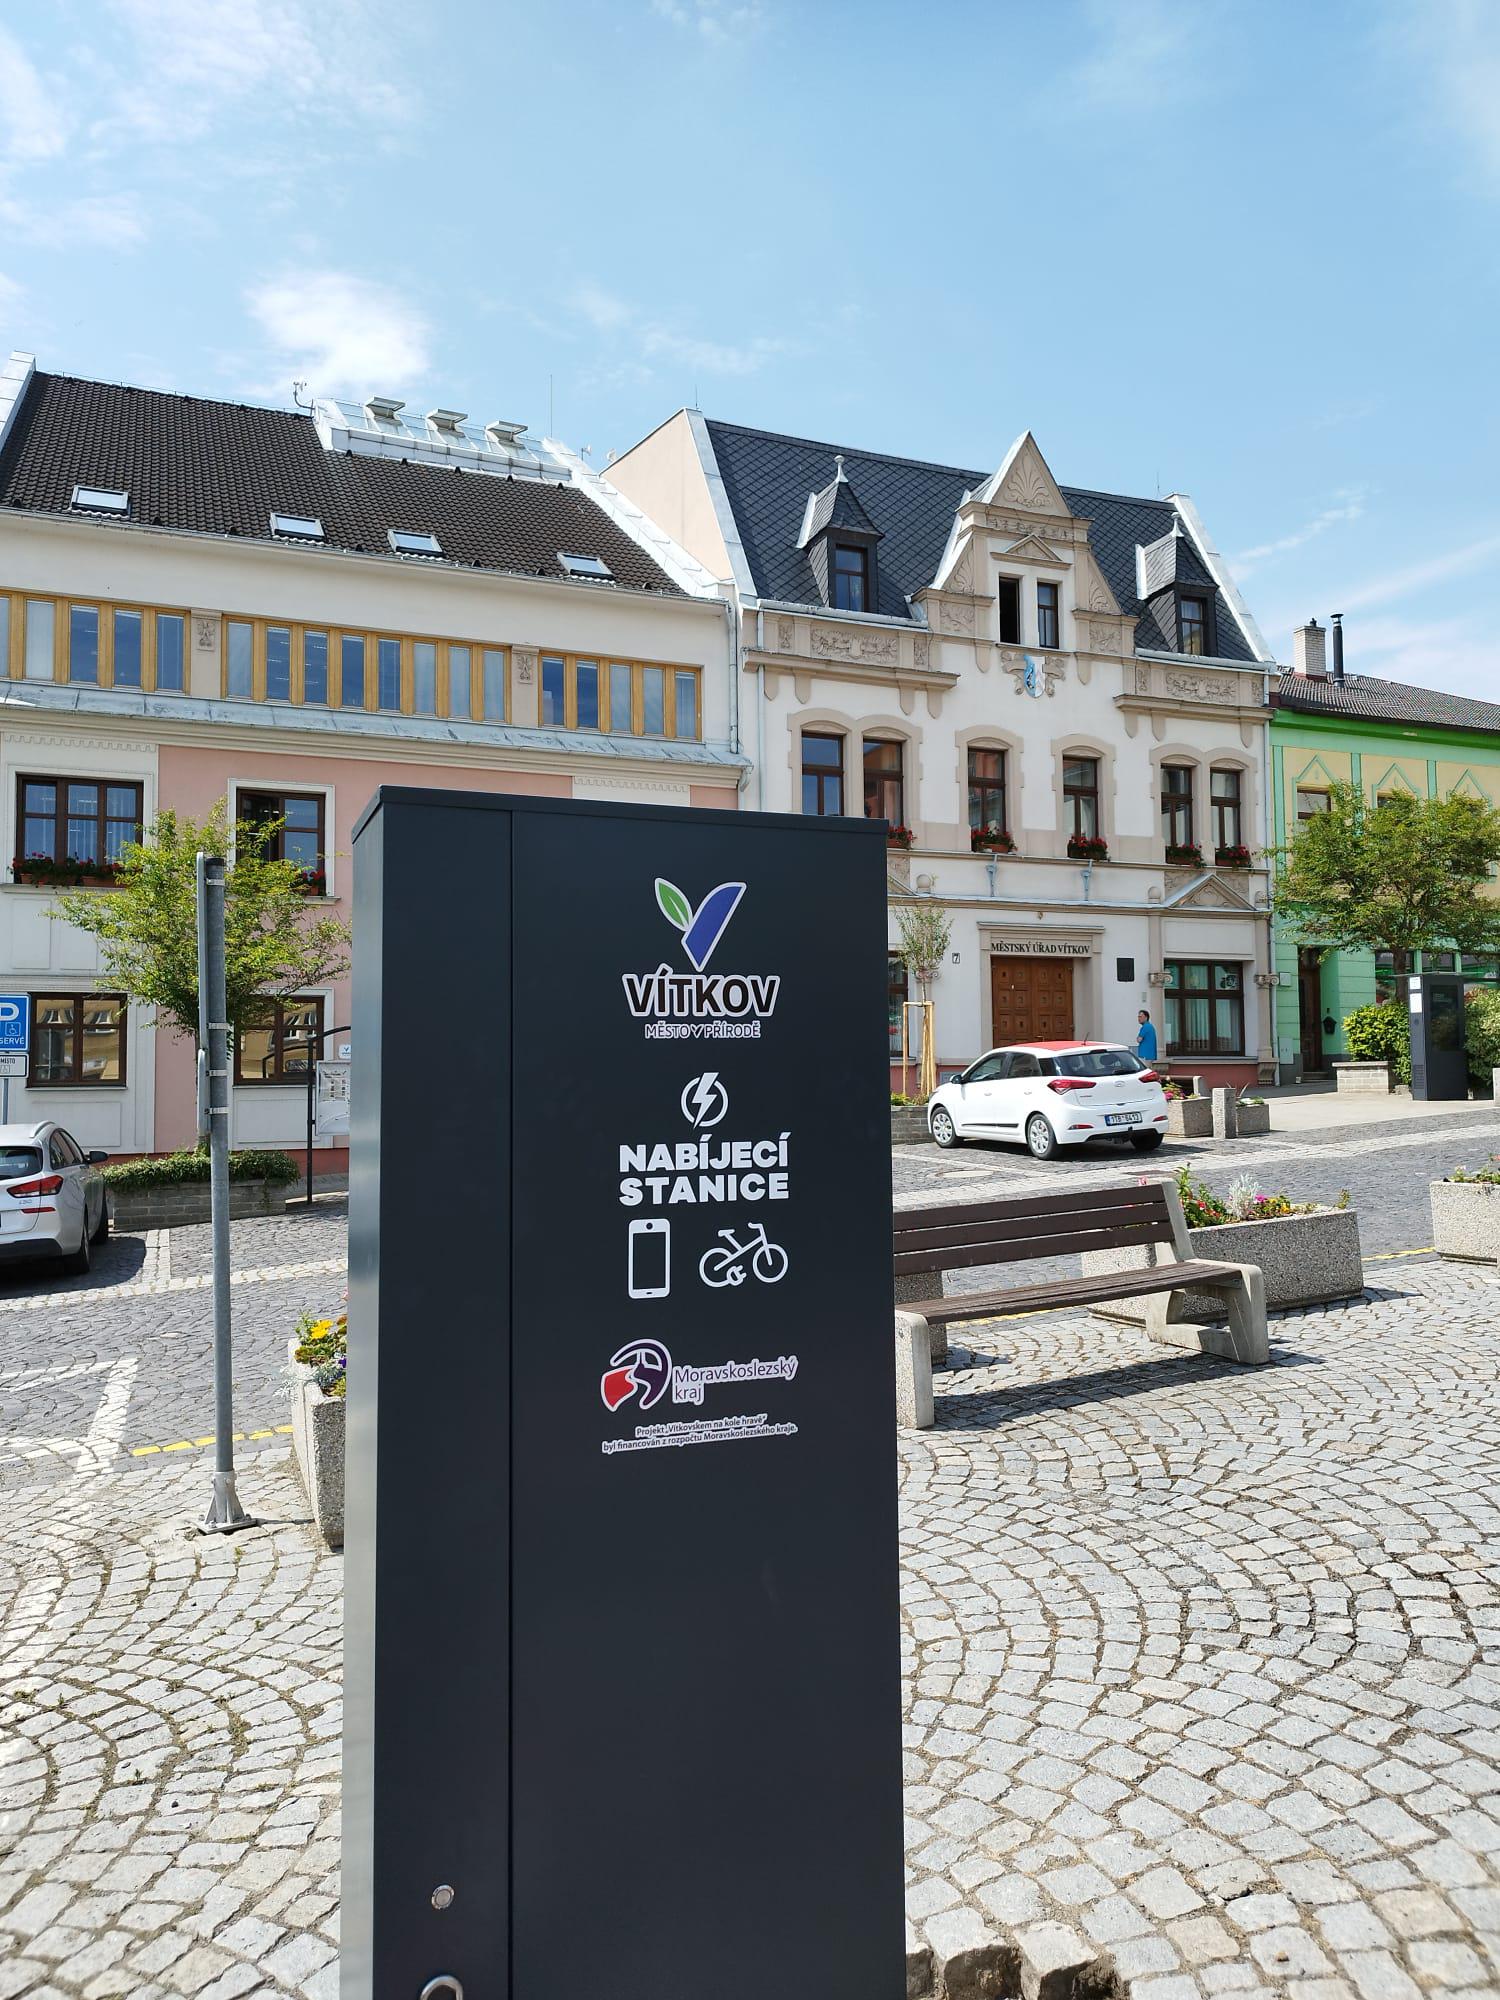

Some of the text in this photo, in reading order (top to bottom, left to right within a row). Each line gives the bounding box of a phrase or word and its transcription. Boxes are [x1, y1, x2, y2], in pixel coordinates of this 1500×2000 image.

[991, 941, 1090, 954] MĚSTSKÝ ÚŘAD VÍTKOV
[622, 963, 780, 1017] VÍTKOV
[645, 1020, 690, 1039] MĚSTO
[704, 1020, 760, 1039] PŘÍRODĚ
[619, 1132, 791, 1172] NABÍJECÍ
[619, 1173, 789, 1206] STANICE
[673, 1356, 798, 1384] Moravskoslezský
[674, 1384, 703, 1404] kraj
[603, 1441, 616, 1452] byl
[617, 1438, 661, 1449] financován
[668, 1434, 702, 1446] rozpočtu
[704, 1426, 775, 1441] Moravskoslezského
[776, 1424, 797, 1434] kraje.
[636, 1425, 664, 1438] Projekt
[713, 1420, 723, 1428] na
[724, 1417, 740, 1427] kole
